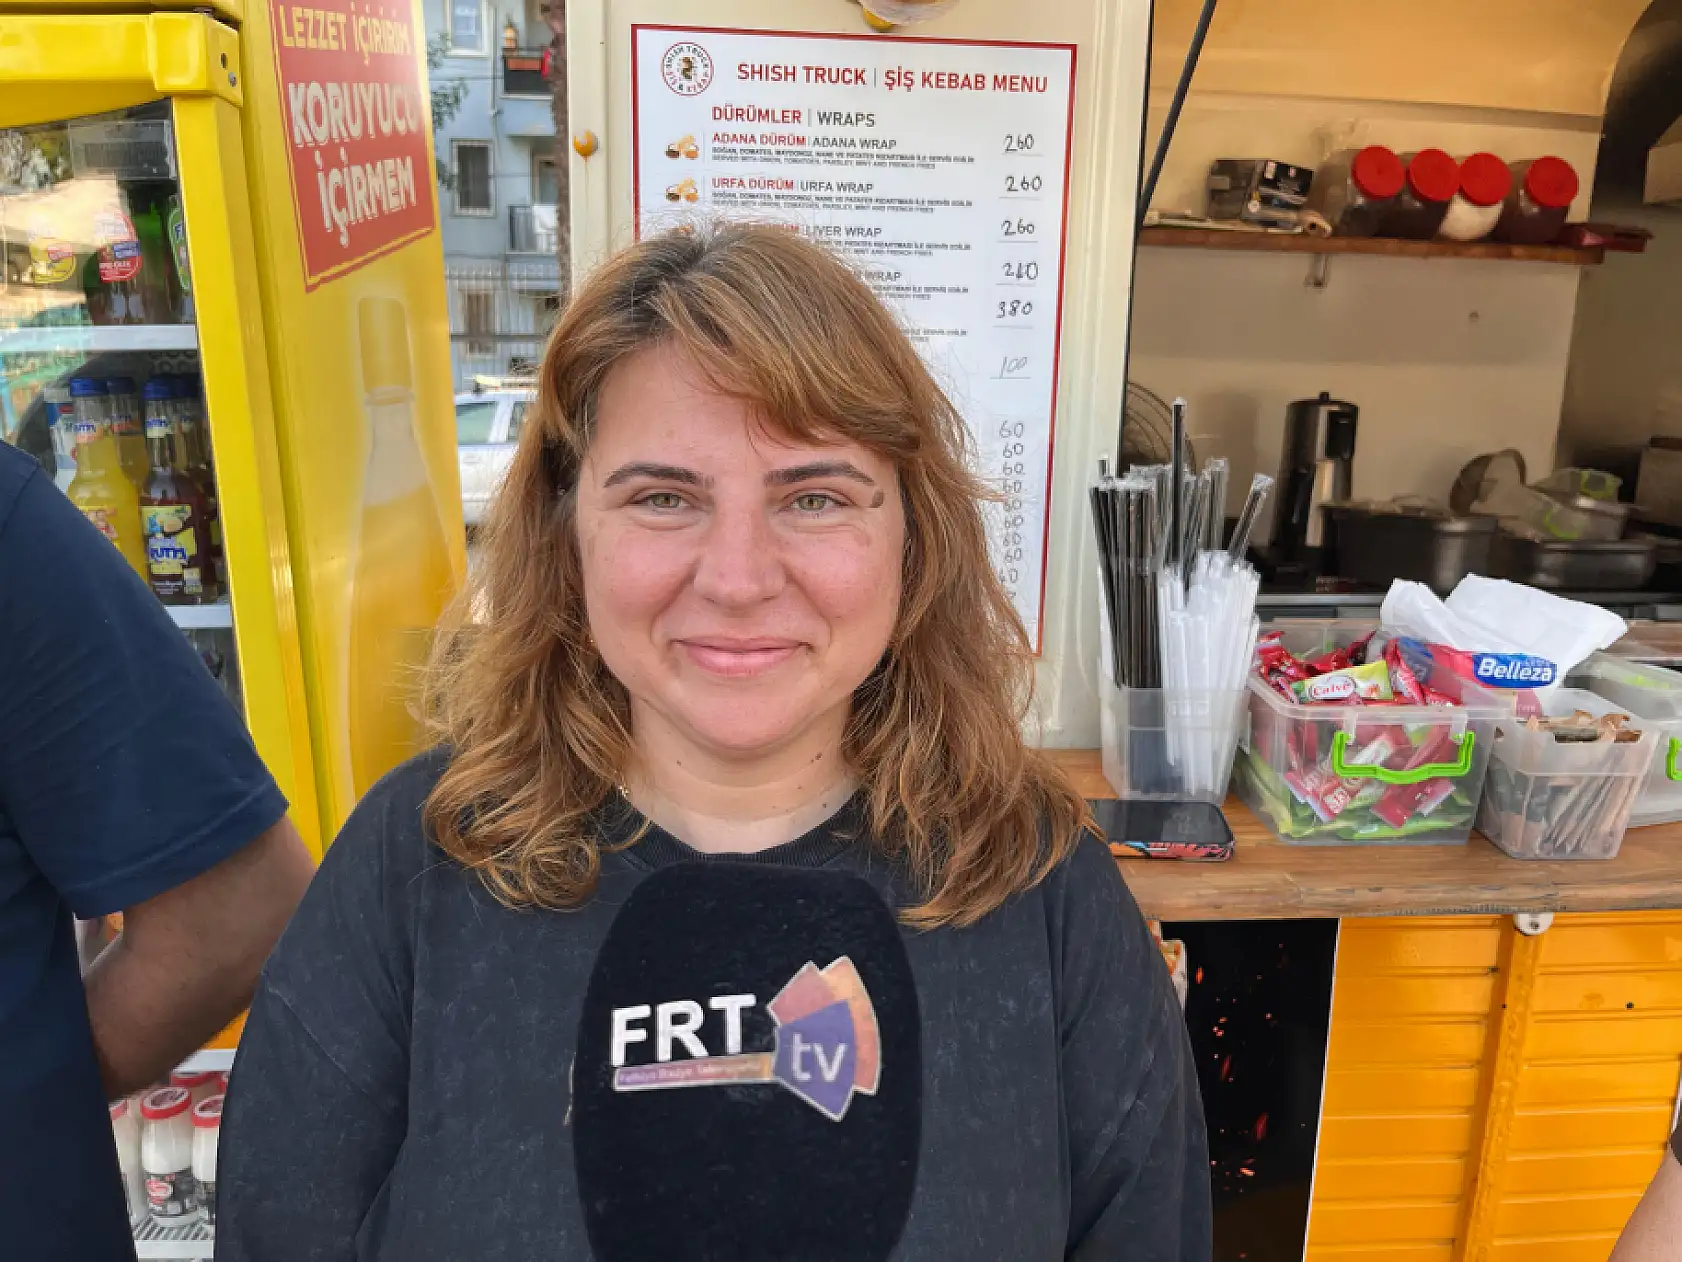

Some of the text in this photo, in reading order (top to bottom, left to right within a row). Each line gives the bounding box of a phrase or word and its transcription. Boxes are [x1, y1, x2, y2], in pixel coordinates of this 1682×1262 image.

[279, 4, 347, 51] LEZZET
[737, 63, 1048, 93] SHISH TRUCK ŞİŞ KEBAB MENU
[288, 81, 420, 148] KORUYUCU
[711, 102, 876, 127] DÜRÜMLER WRAPS
[711, 131, 897, 150] ADANA DÜRÜM ADANA WRAP
[1004, 133, 1035, 154] 260
[711, 176, 873, 194] URFA DÜRÜM URFA WRAP
[1005, 175, 1043, 192] 260
[804, 225, 841, 237] LIVER
[844, 226, 882, 238] WRAP
[1001, 218, 1035, 237] 260
[864, 271, 902, 282] WRAP
[996, 299, 1033, 318] 380
[1001, 355, 1028, 377] 100
[999, 420, 1024, 439] 60
[1002, 442, 1024, 459] 60
[1002, 461, 1024, 476] 60
[1477, 658, 1552, 682] Belleza
[610, 993, 757, 1067] FRT
[790, 1033, 849, 1083] tv
